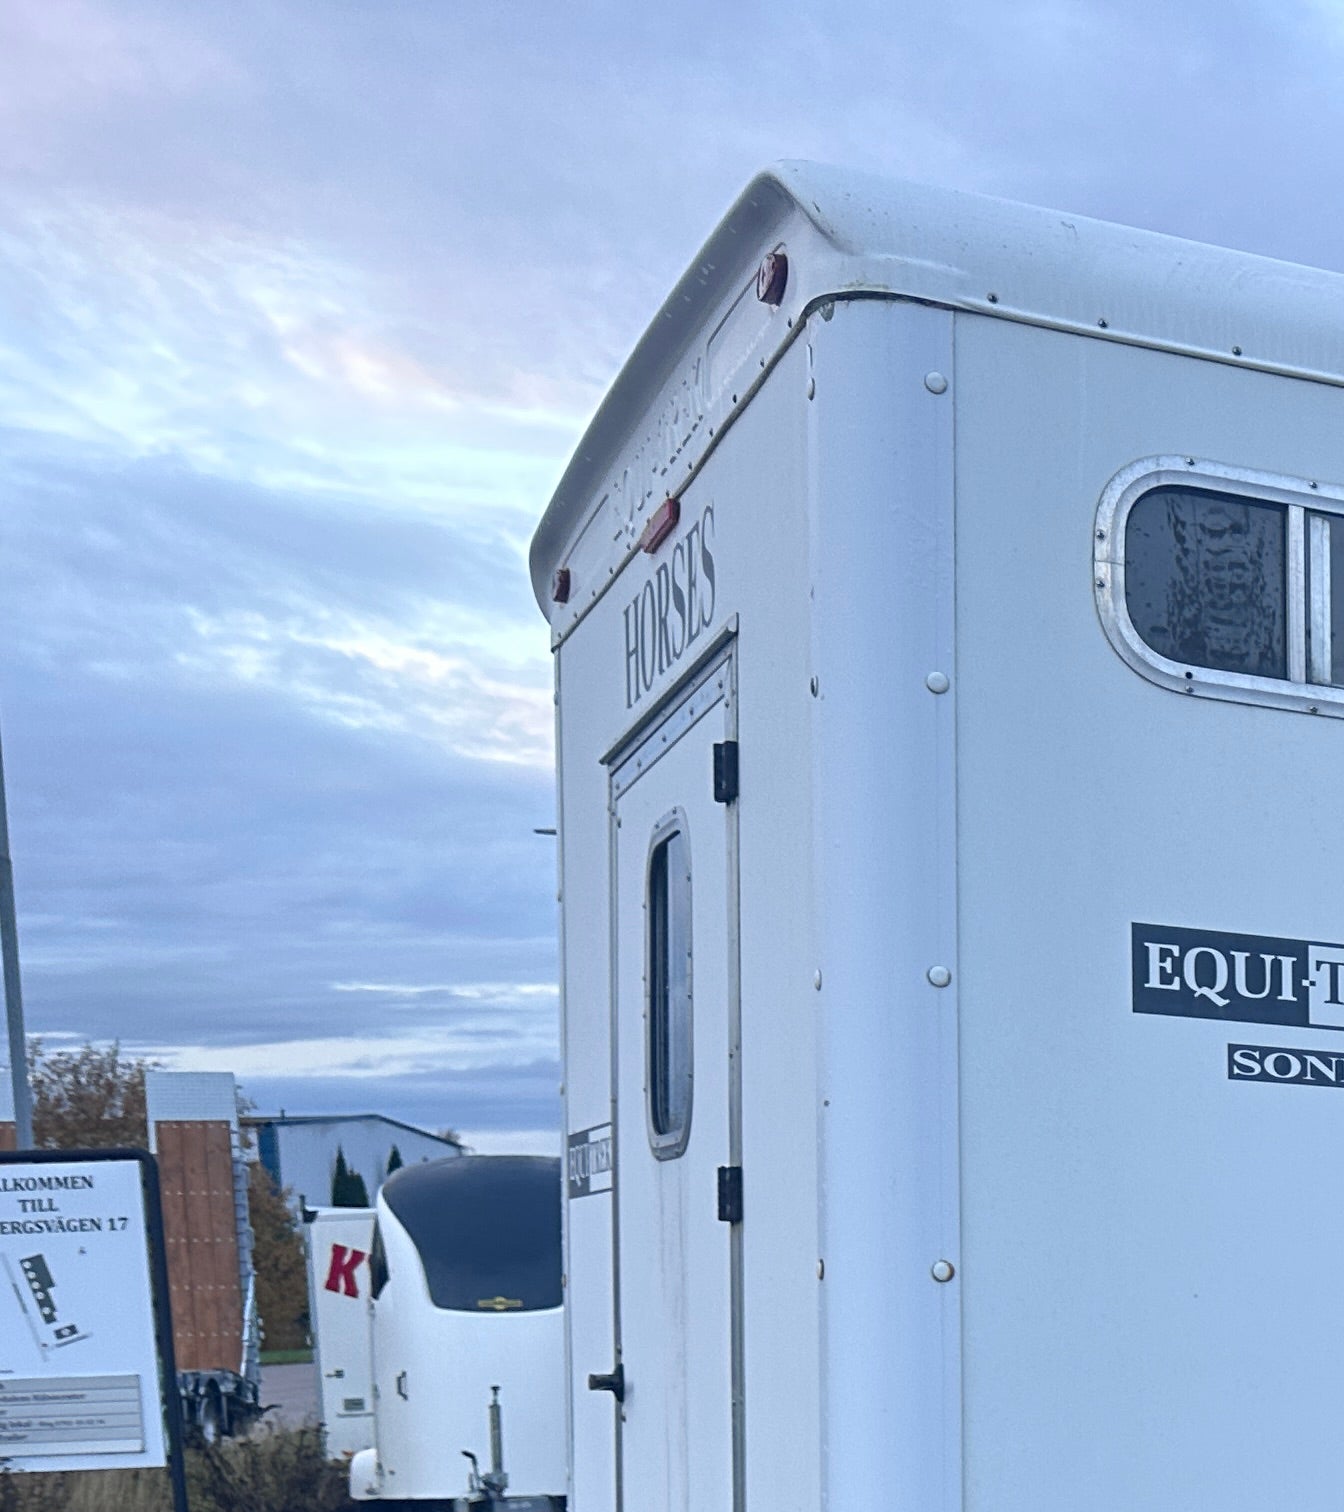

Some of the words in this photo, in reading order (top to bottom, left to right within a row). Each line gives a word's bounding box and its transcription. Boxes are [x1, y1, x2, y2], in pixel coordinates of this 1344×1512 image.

[623, 500, 716, 709] HORSES
[0, 1176, 94, 1192] LKOMMEN
[17, 1198, 59, 1213] TILL
[107, 1217, 128, 1232] 17
[324, 1243, 371, 1299] K
